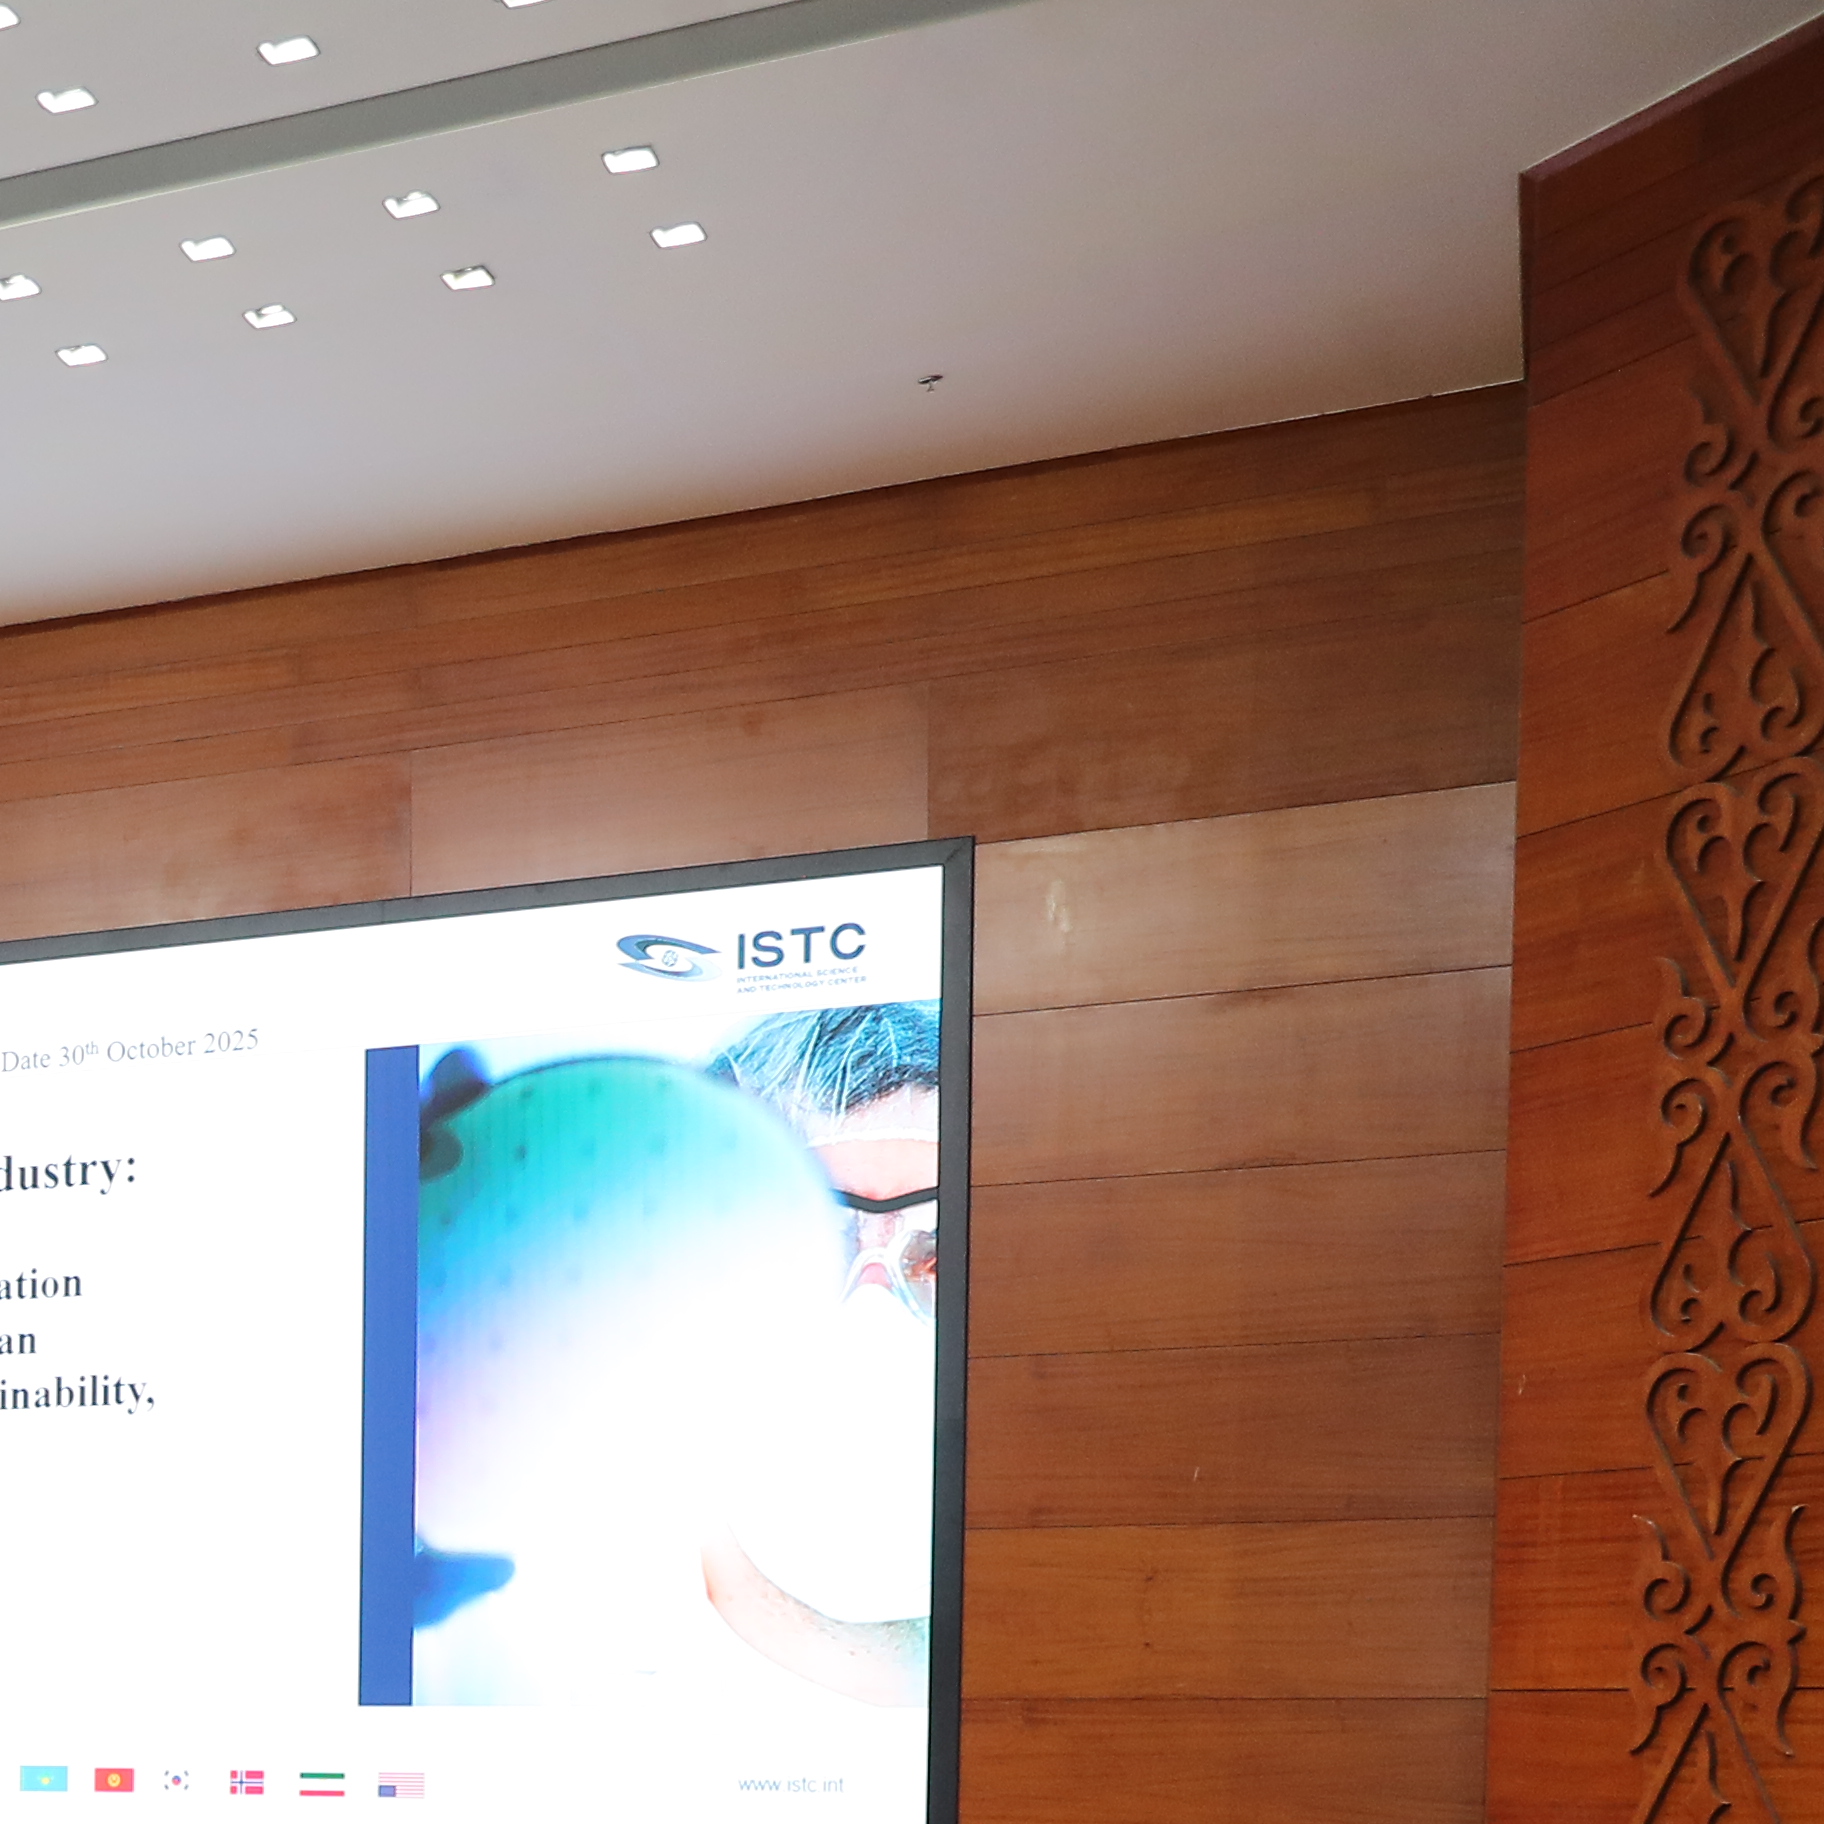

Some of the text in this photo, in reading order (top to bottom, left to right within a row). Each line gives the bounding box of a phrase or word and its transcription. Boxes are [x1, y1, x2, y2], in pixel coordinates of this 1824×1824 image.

[737, 922, 866, 969] ISTC
[737, 966, 858, 983] INTERNATIONAL SCIENCE
[737, 976, 867, 994] AND TECHNOLOGY CENTER
[1, 1050, 51, 1073] Date
[106, 1035, 197, 1063] October
[203, 1027, 259, 1054] 2025
